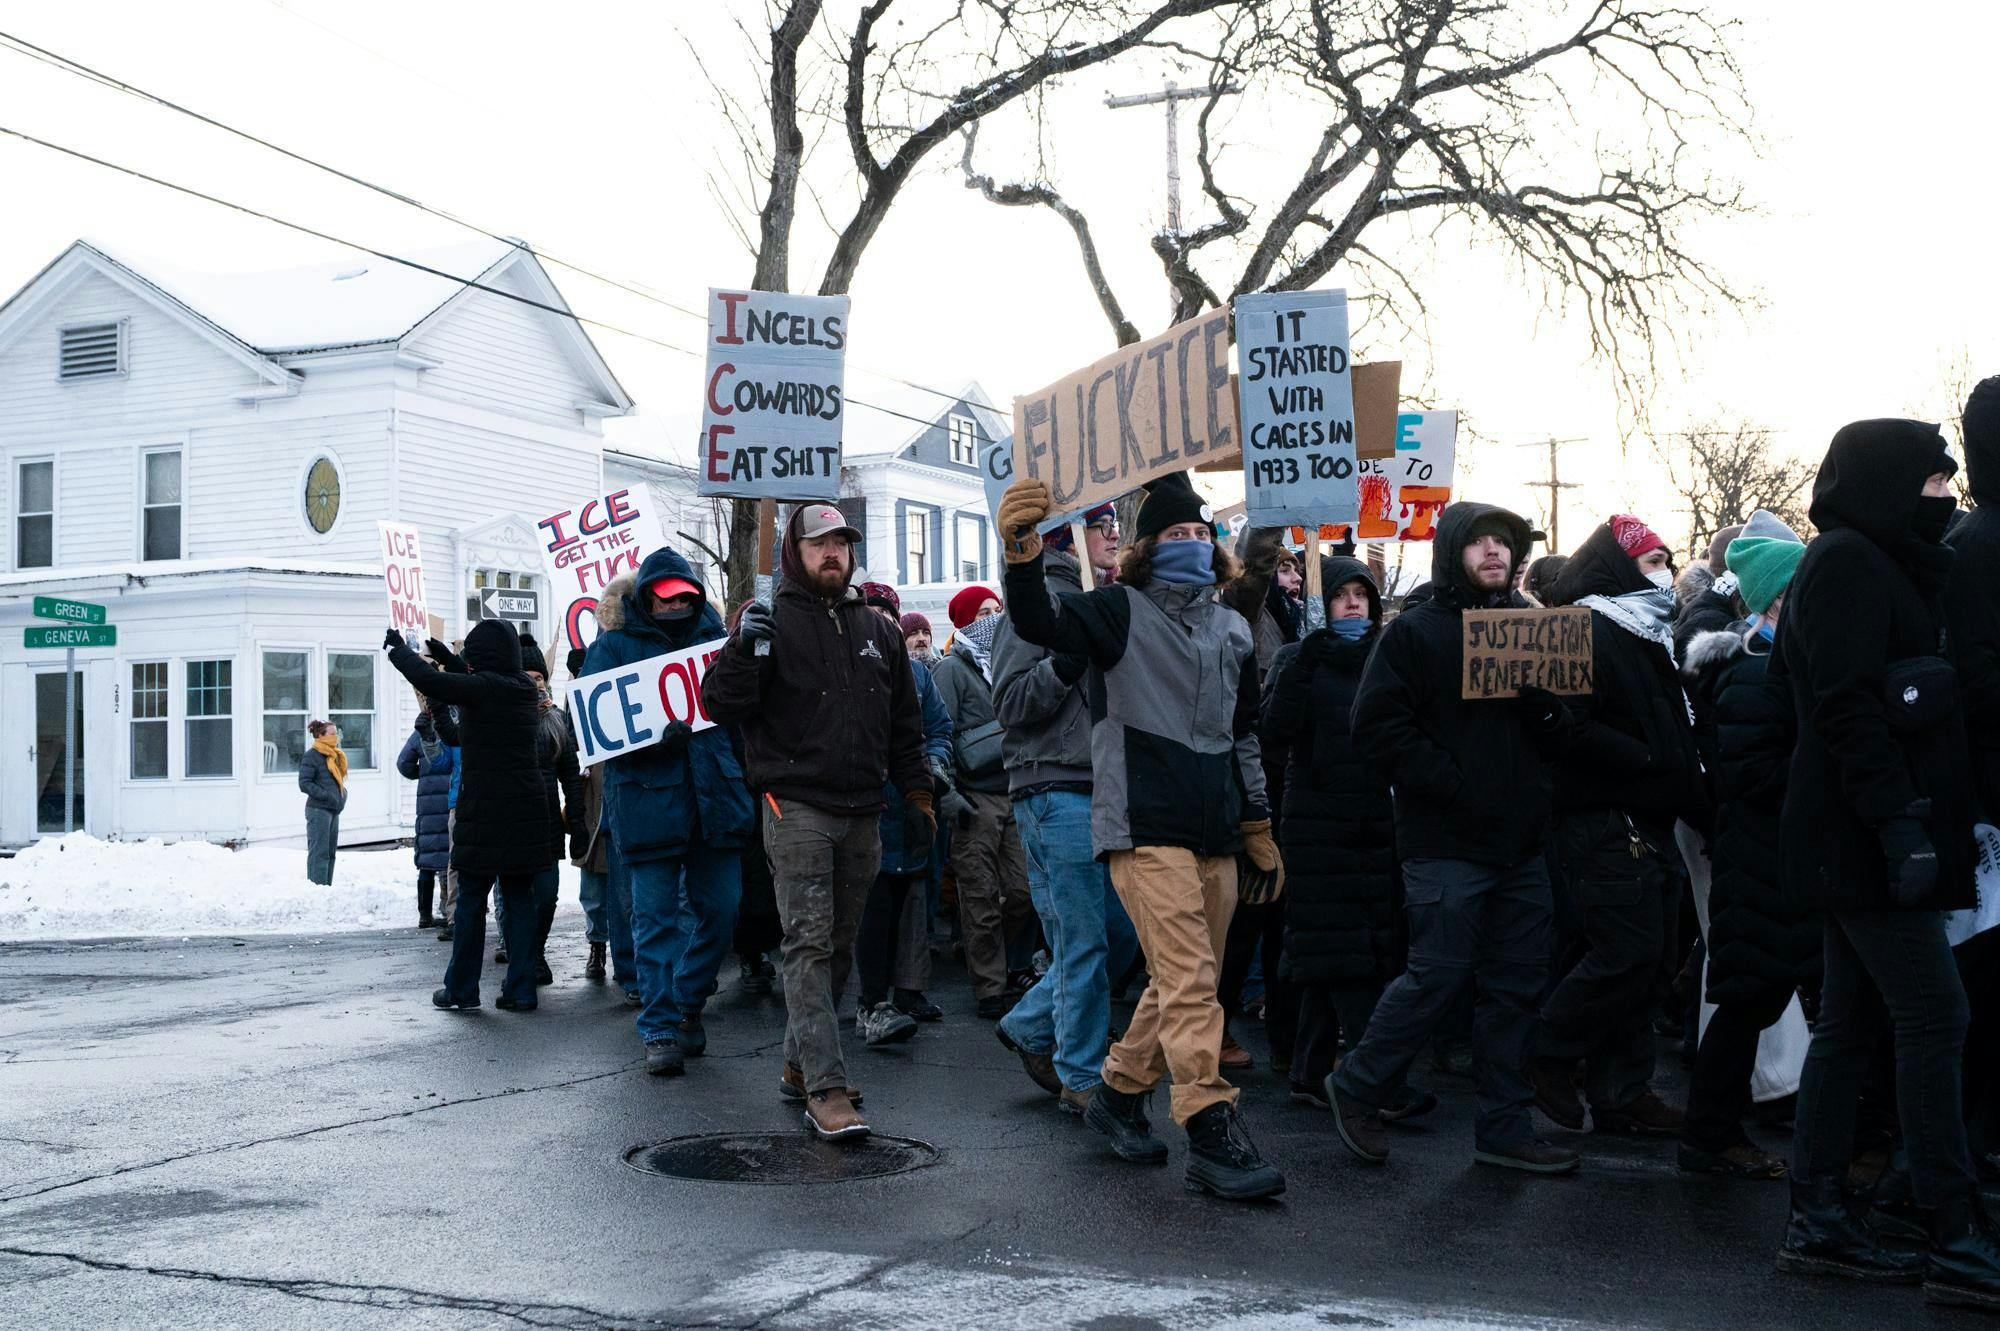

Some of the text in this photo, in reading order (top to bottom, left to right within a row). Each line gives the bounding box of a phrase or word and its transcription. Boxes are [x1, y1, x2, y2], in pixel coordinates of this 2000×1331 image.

[715, 292, 844, 350] INCELS
[1276, 310, 1306, 343] IT
[1248, 344, 1348, 382] STARTED
[707, 362, 842, 421] COWARDS
[1268, 385, 1324, 416] WITH
[707, 424, 838, 482] EAT SHIT
[1250, 419, 1352, 450] CAGES IN
[1252, 453, 1354, 488] 1933 TOO
[1405, 457, 1433, 481] TO
[538, 489, 641, 553] ICE
[386, 530, 418, 559] ICE
[554, 528, 635, 569] GET THE
[387, 563, 422, 602] OUT
[575, 546, 642, 594] FUCK
[55, 603, 88, 619] GREEN
[391, 600, 427, 630] NOW
[499, 598, 532, 611] ONE WAY
[45, 630, 90, 644] GENEVA
[99, 635, 107, 643] ST
[1469, 613, 1592, 657] JUSTICE FOR
[1469, 656, 1533, 697] RENEE
[573, 649, 721, 757] ICE OU
